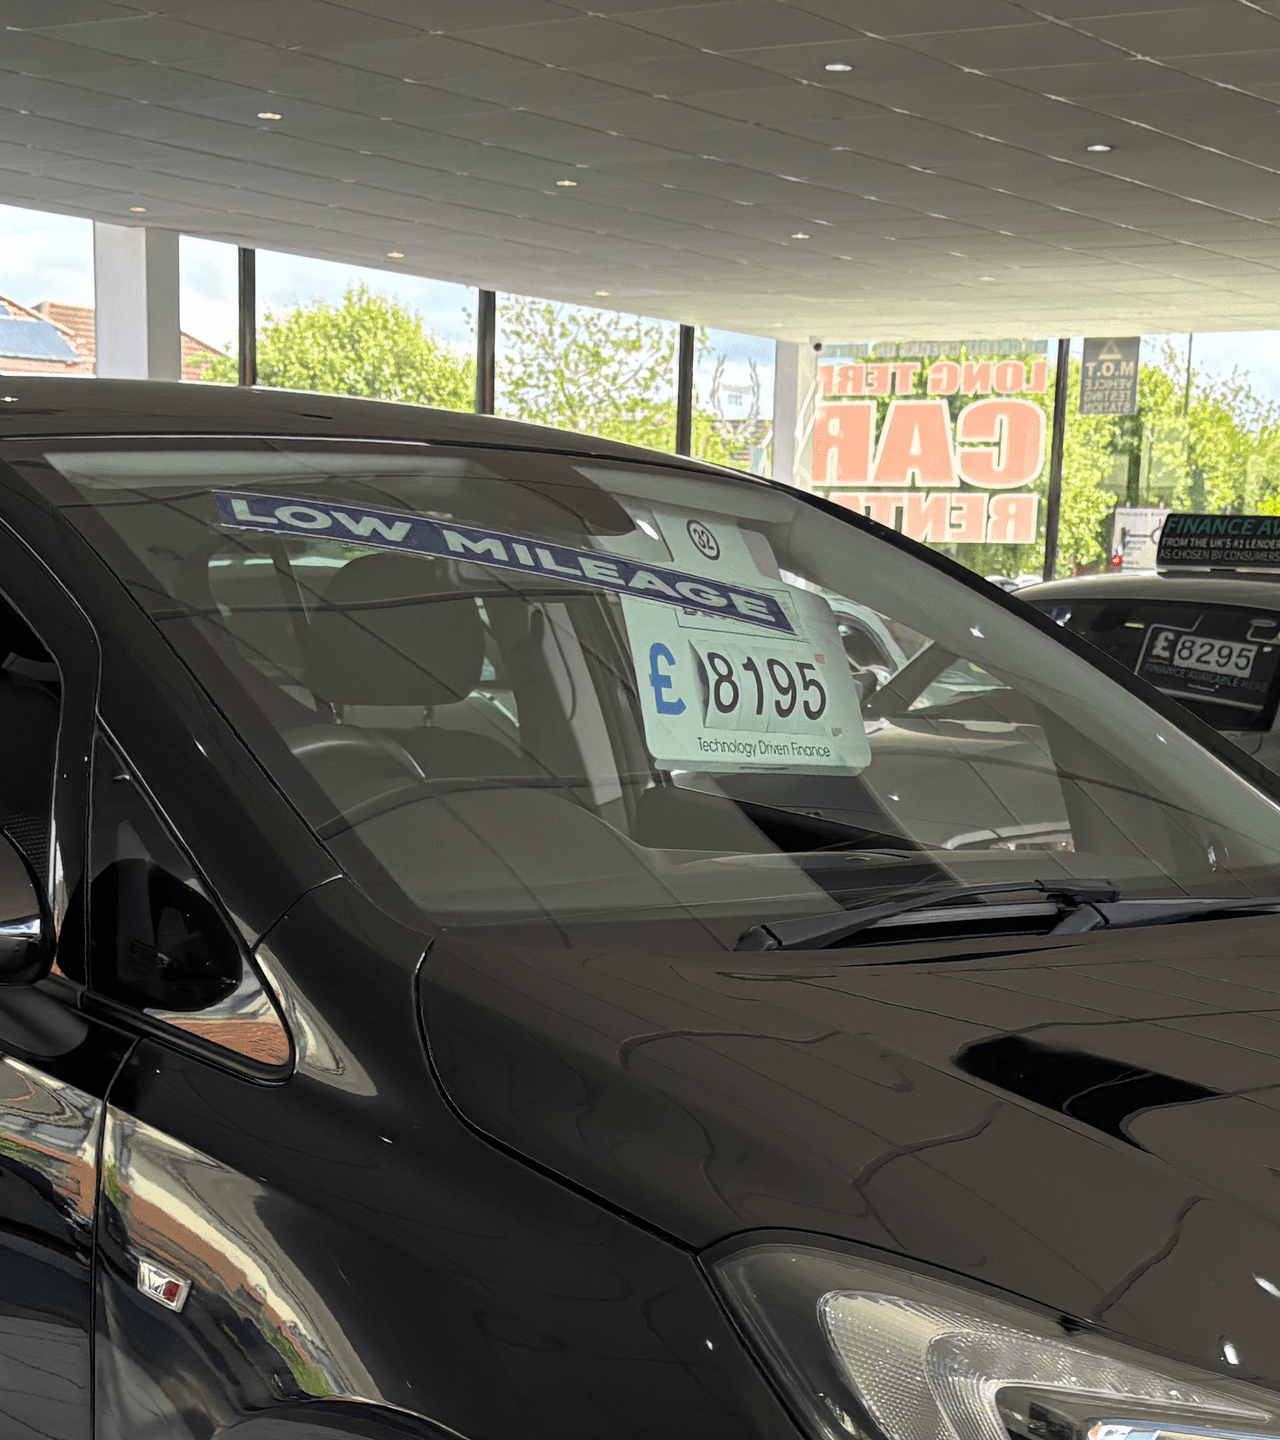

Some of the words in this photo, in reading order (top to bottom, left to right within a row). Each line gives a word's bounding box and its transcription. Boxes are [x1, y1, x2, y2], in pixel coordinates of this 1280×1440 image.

[1164, 517, 1253, 535] FINANCE
[1162, 538, 1188, 548] FROM
[1189, 538, 1208, 548] THE
[230, 498, 413, 543] LOW
[442, 529, 776, 622] MILEAGE
[1172, 549, 1210, 560] CHOSEN
[1152, 631, 1175, 658] £
[1177, 640, 1254, 671] 8295
[649, 642, 687, 716] £
[707, 651, 827, 721] 8195
[697, 736, 757, 758] Technology
[759, 740, 790, 756] Driven
[791, 741, 831, 758] Finance
